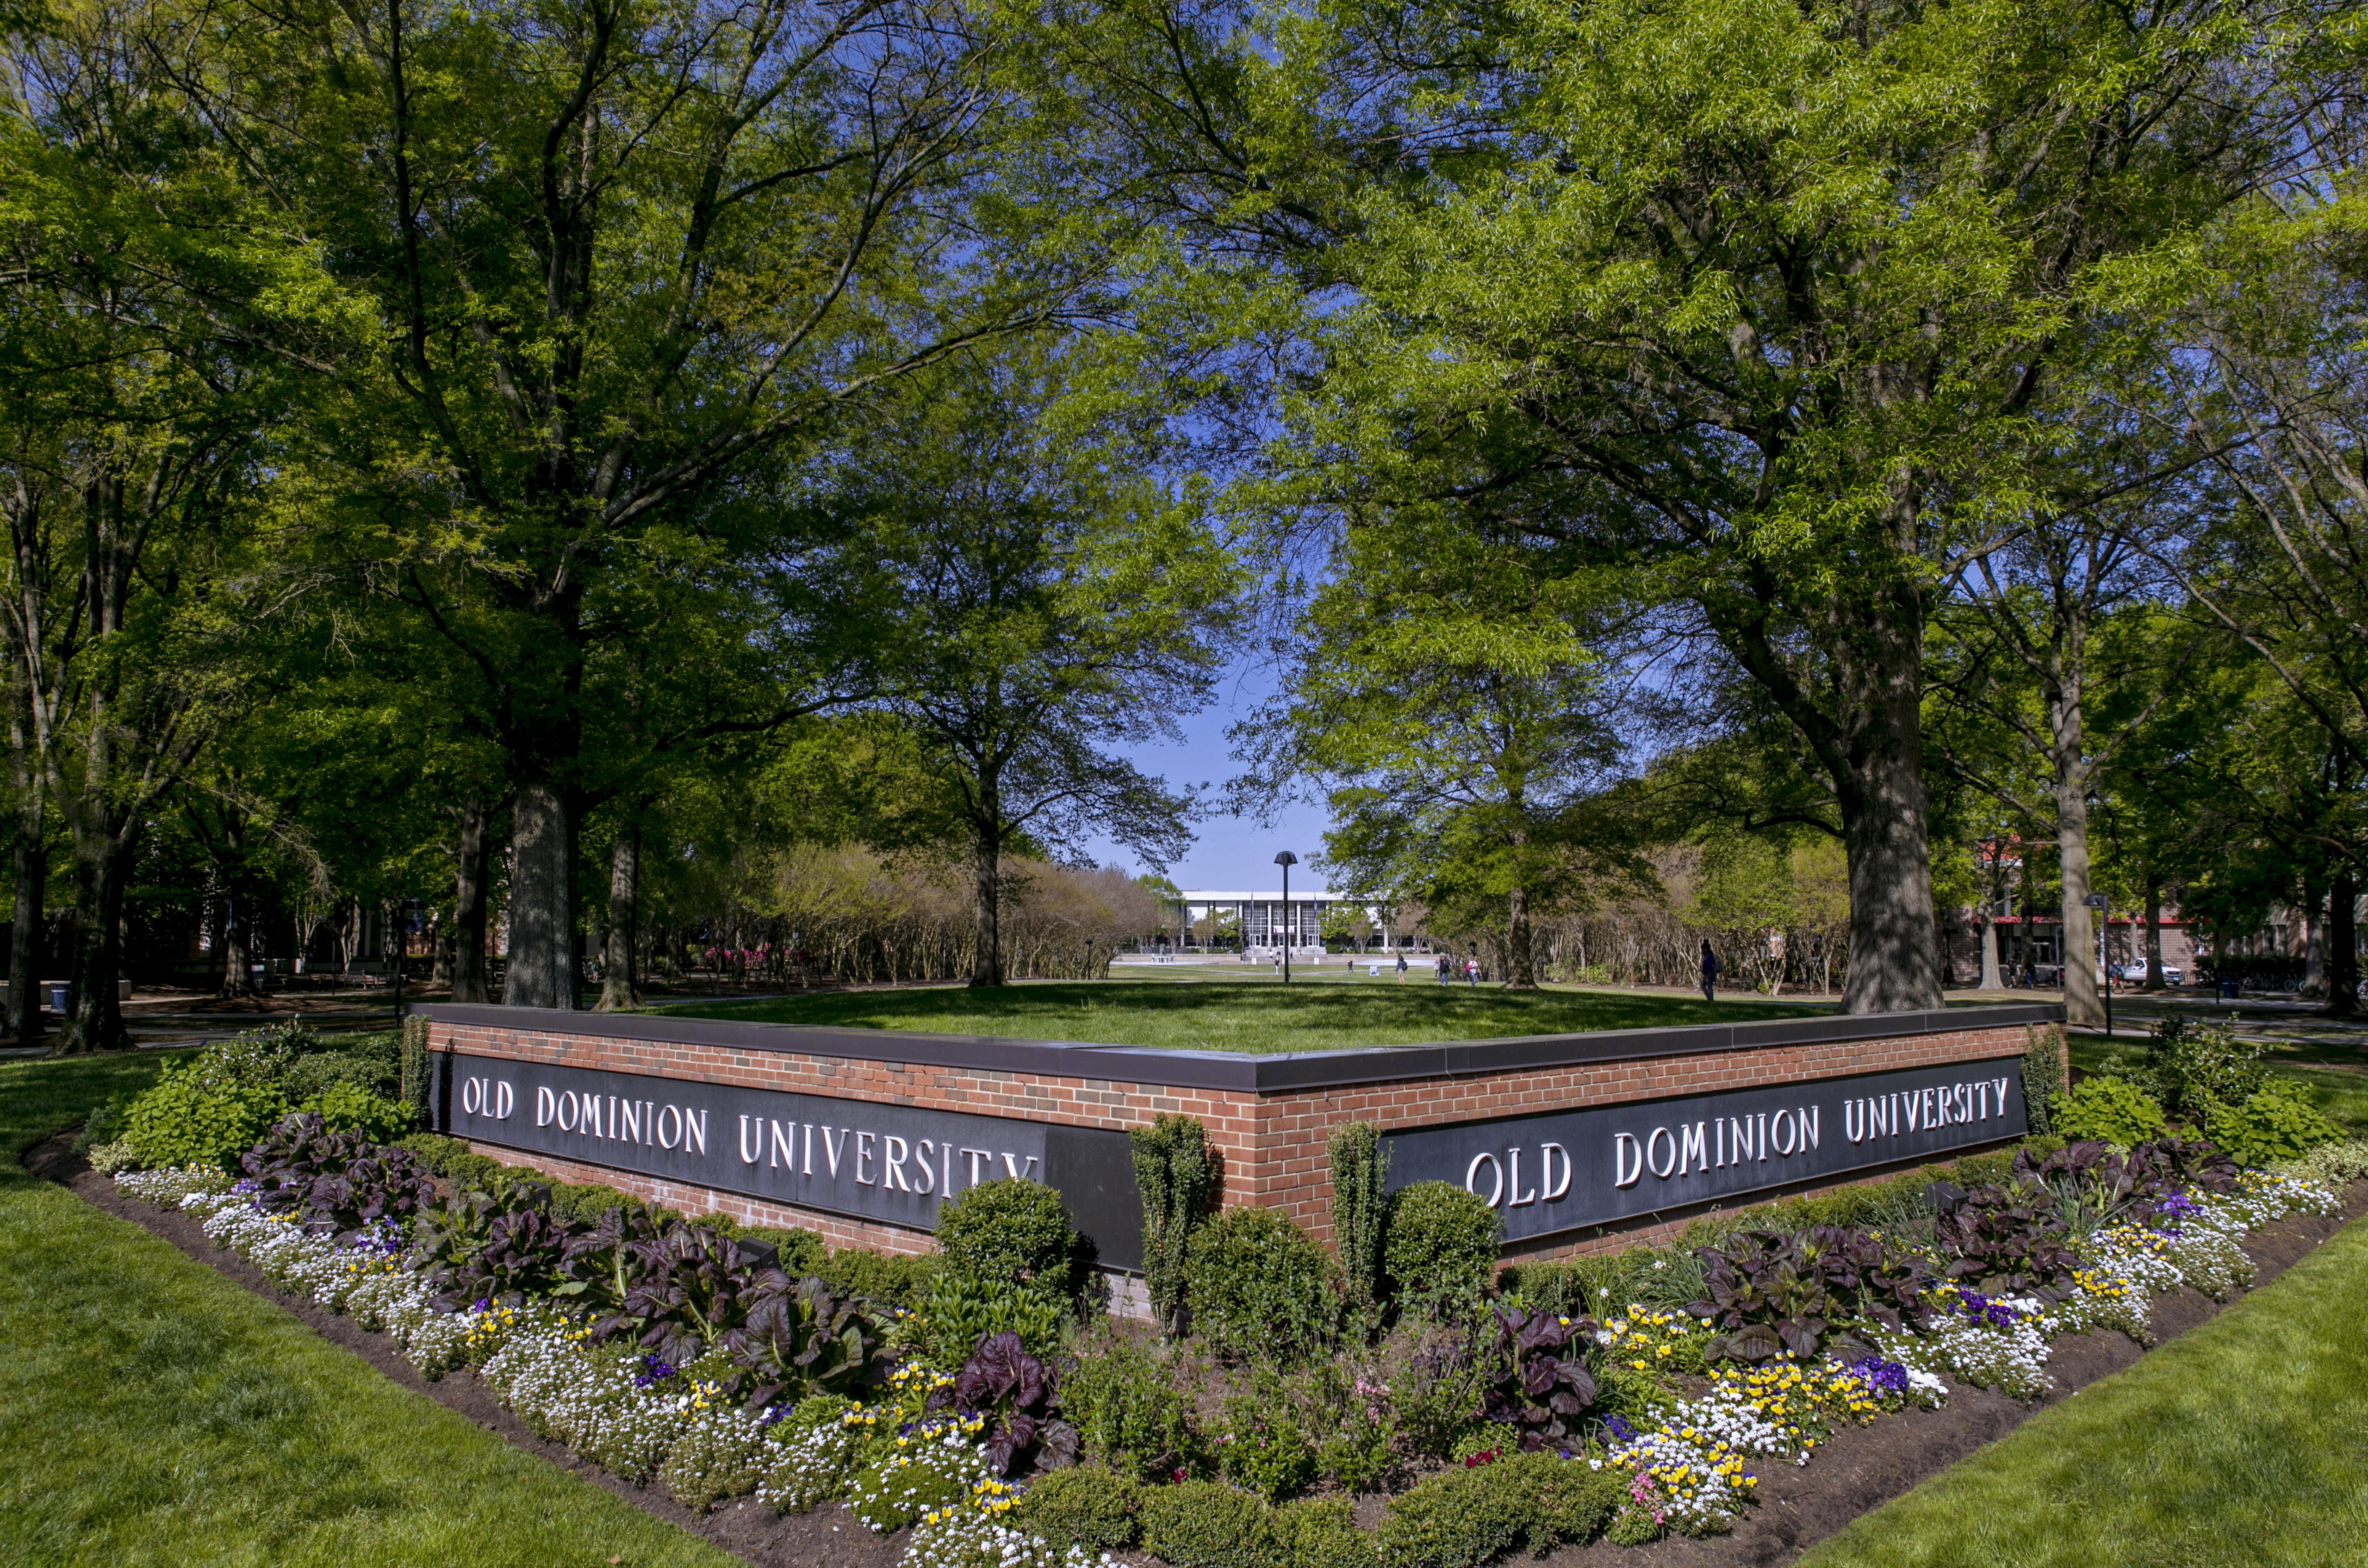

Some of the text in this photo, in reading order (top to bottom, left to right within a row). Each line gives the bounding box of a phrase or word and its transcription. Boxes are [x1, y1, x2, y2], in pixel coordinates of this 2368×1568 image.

[463, 1077, 514, 1120] OLD
[536, 1085, 709, 1156] DOMINION
[1466, 1077, 2008, 1209] OLD DOMINION UNIVERSITY
